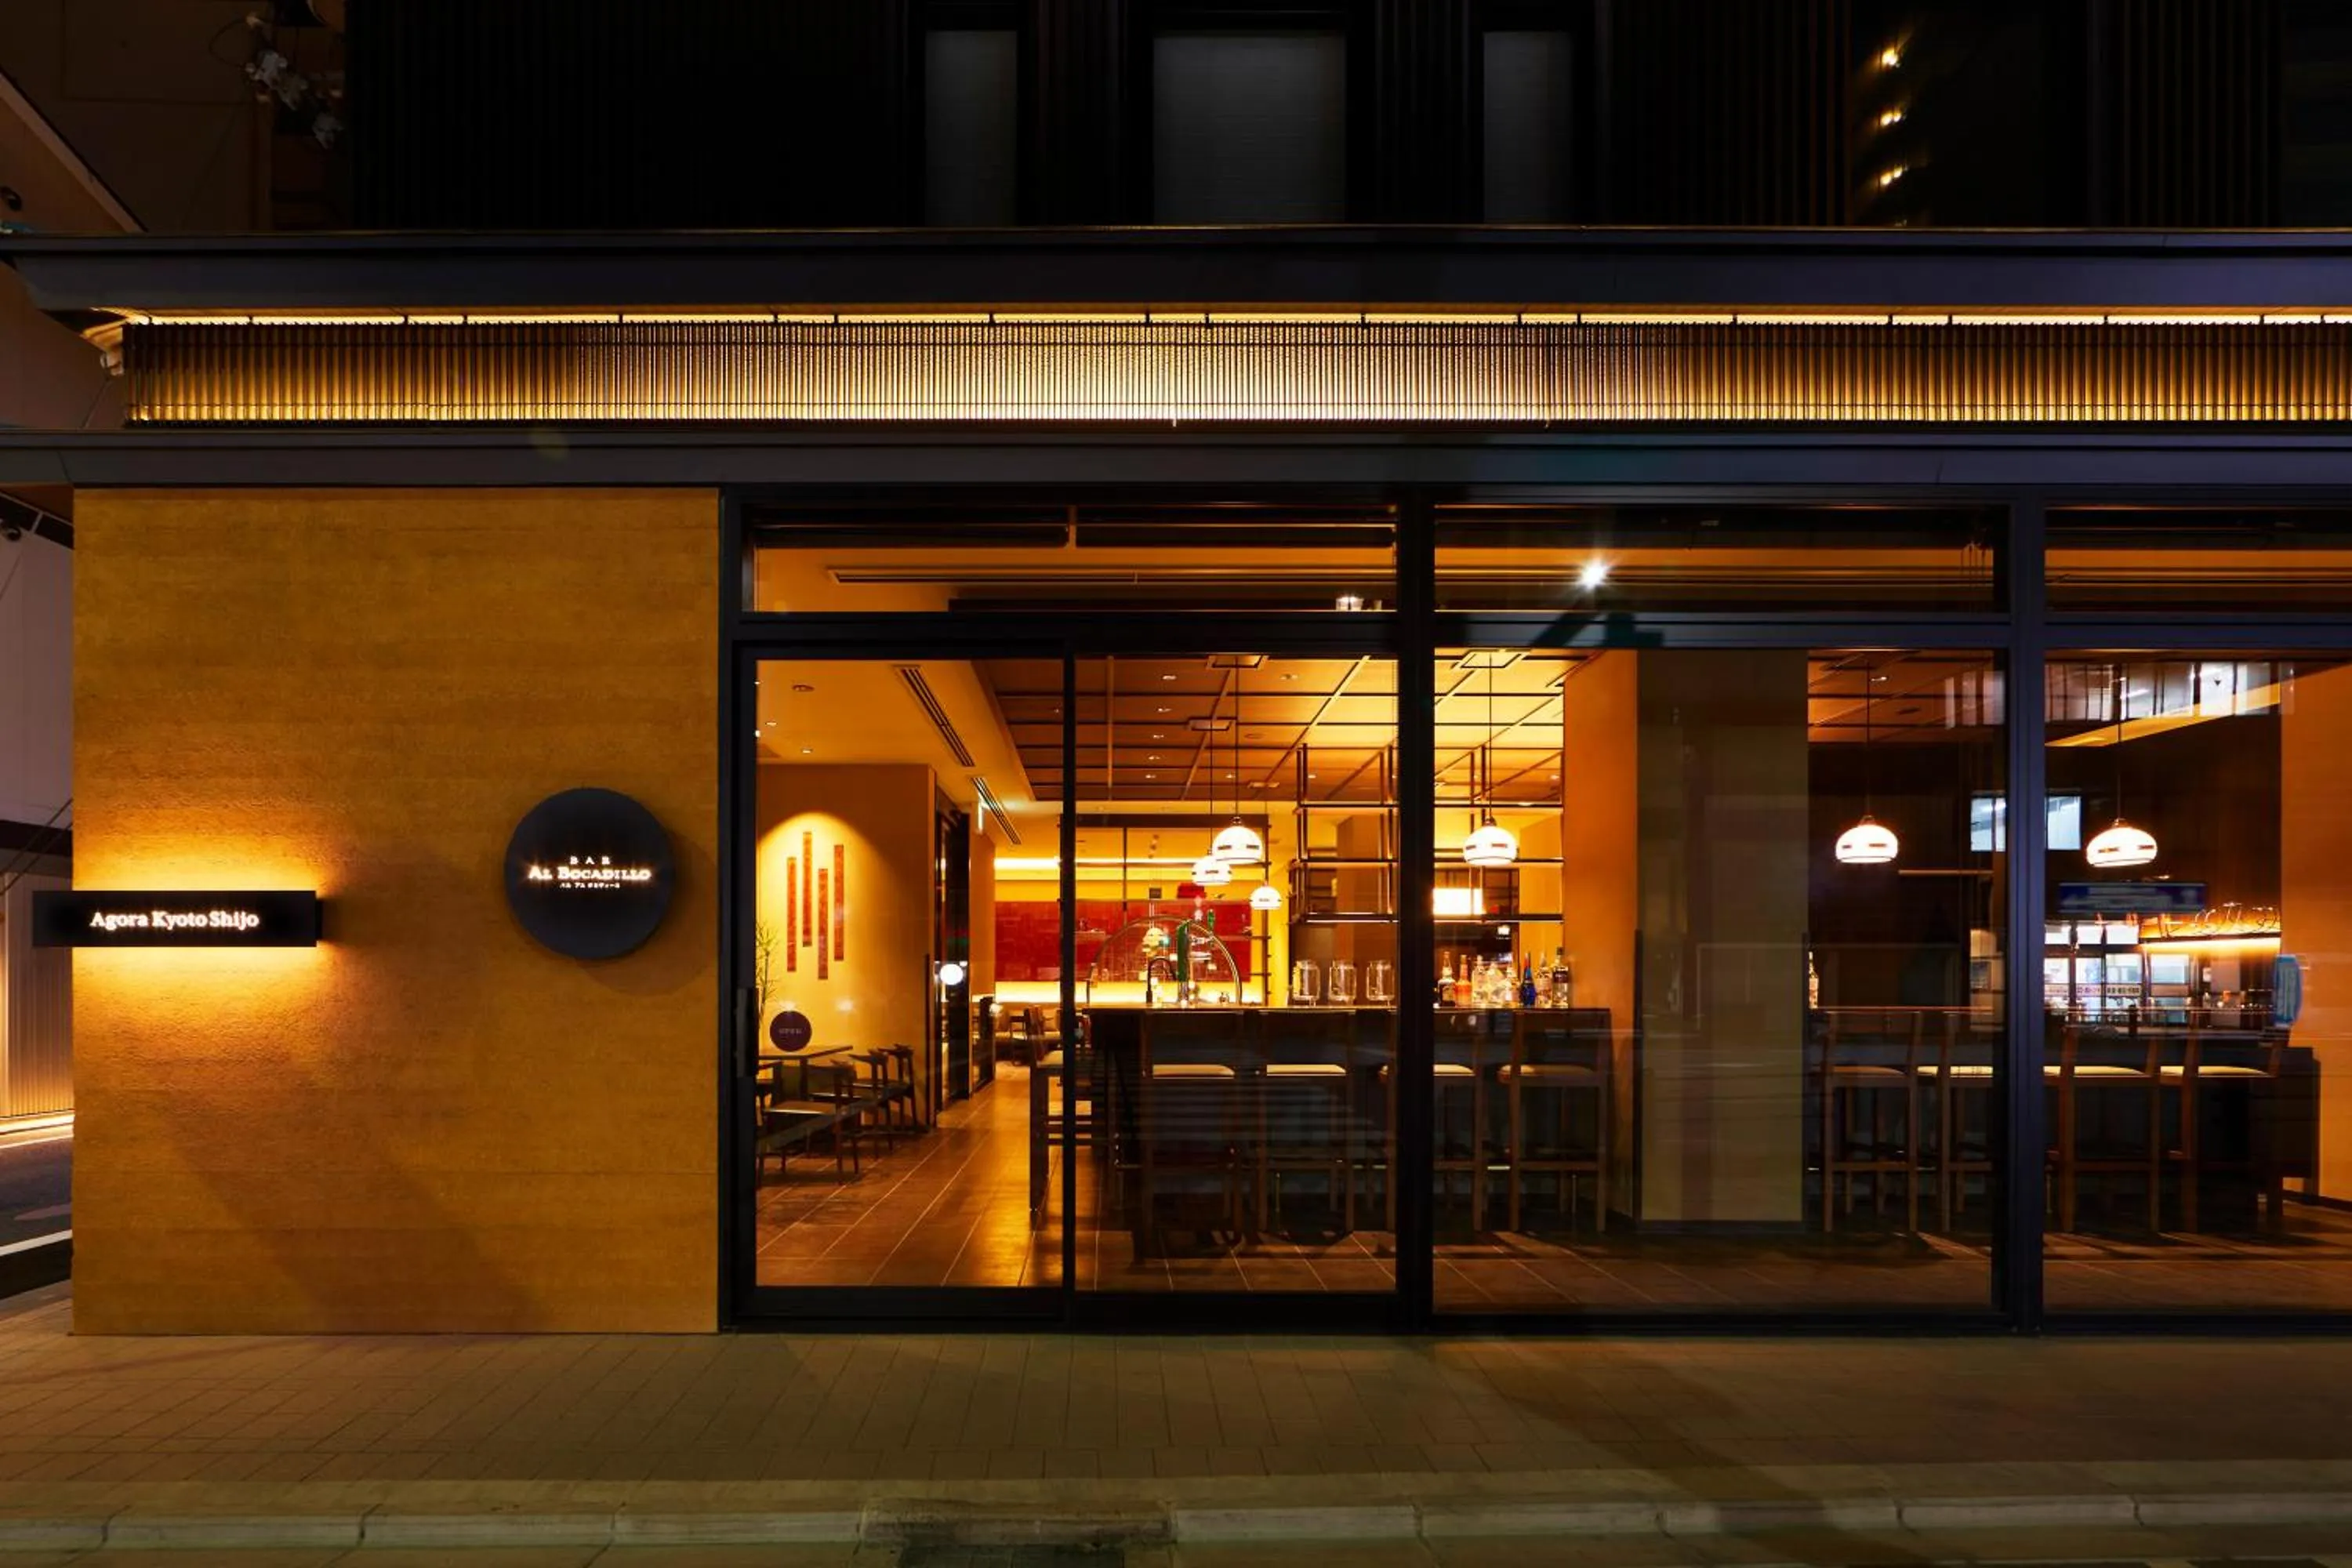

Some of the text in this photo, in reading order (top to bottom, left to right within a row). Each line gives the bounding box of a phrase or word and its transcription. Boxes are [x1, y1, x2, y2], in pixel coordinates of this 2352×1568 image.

[570, 855, 611, 865] BAR
[528, 865, 652, 881] AL BOCADILLO
[90, 910, 260, 931] Agora Kyoto Shijo
